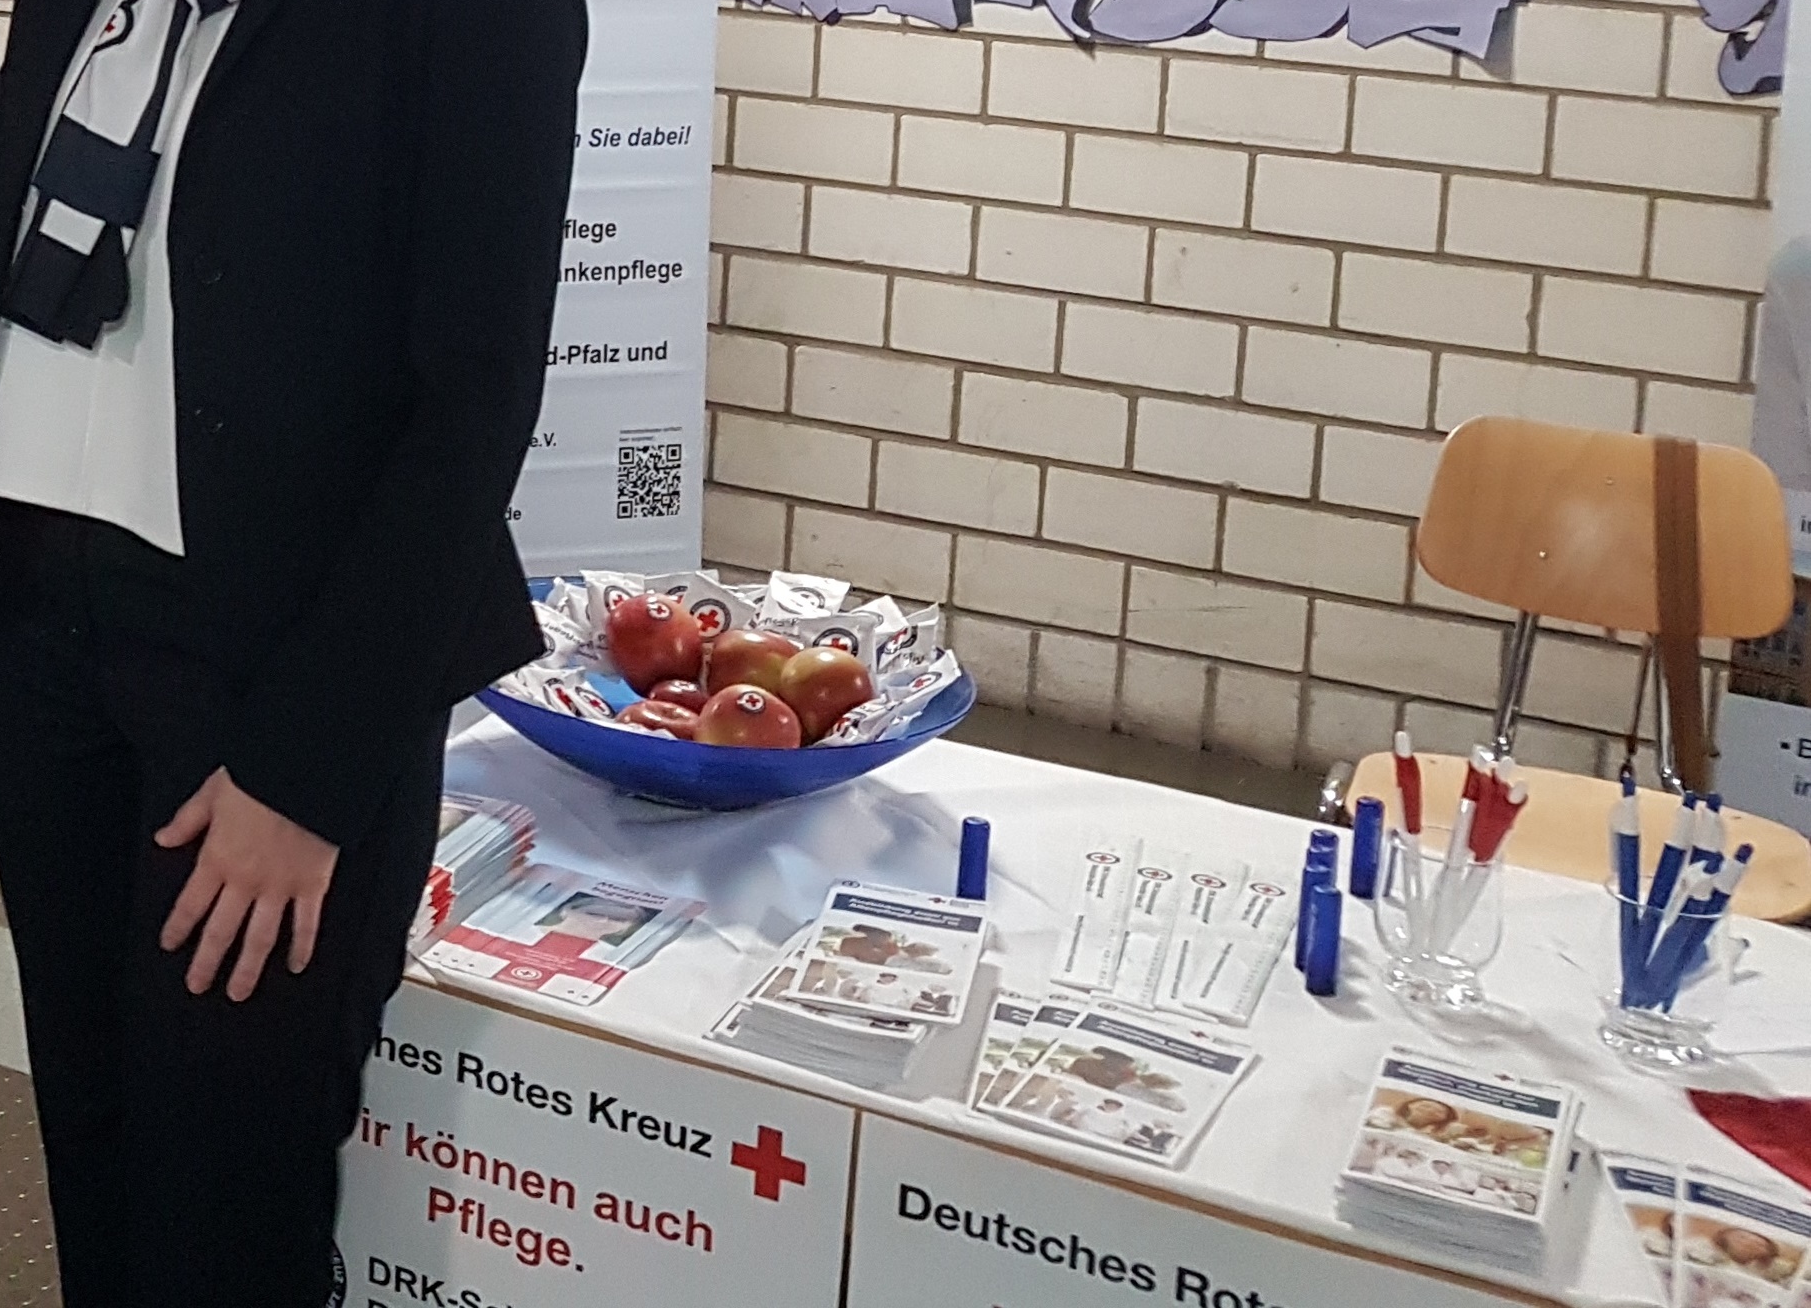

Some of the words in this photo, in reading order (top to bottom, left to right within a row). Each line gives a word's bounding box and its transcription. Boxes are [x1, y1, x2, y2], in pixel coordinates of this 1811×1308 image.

[589, 127, 621, 148] Sie
[627, 125, 691, 147] dabei!
[563, 219, 617, 243] flege
[558, 259, 683, 285] nkenpflege
[545, 343, 620, 366] d-Pfalz
[627, 340, 668, 362] und
[456, 1051, 574, 1117] Rotes
[587, 1092, 714, 1158] Kreuz
[361, 1107, 392, 1147] ir
[405, 1121, 577, 1210] können
[593, 1188, 714, 1253] auch
[427, 1185, 586, 1273] Pflege.
[898, 1182, 1158, 1293] Deutsches
